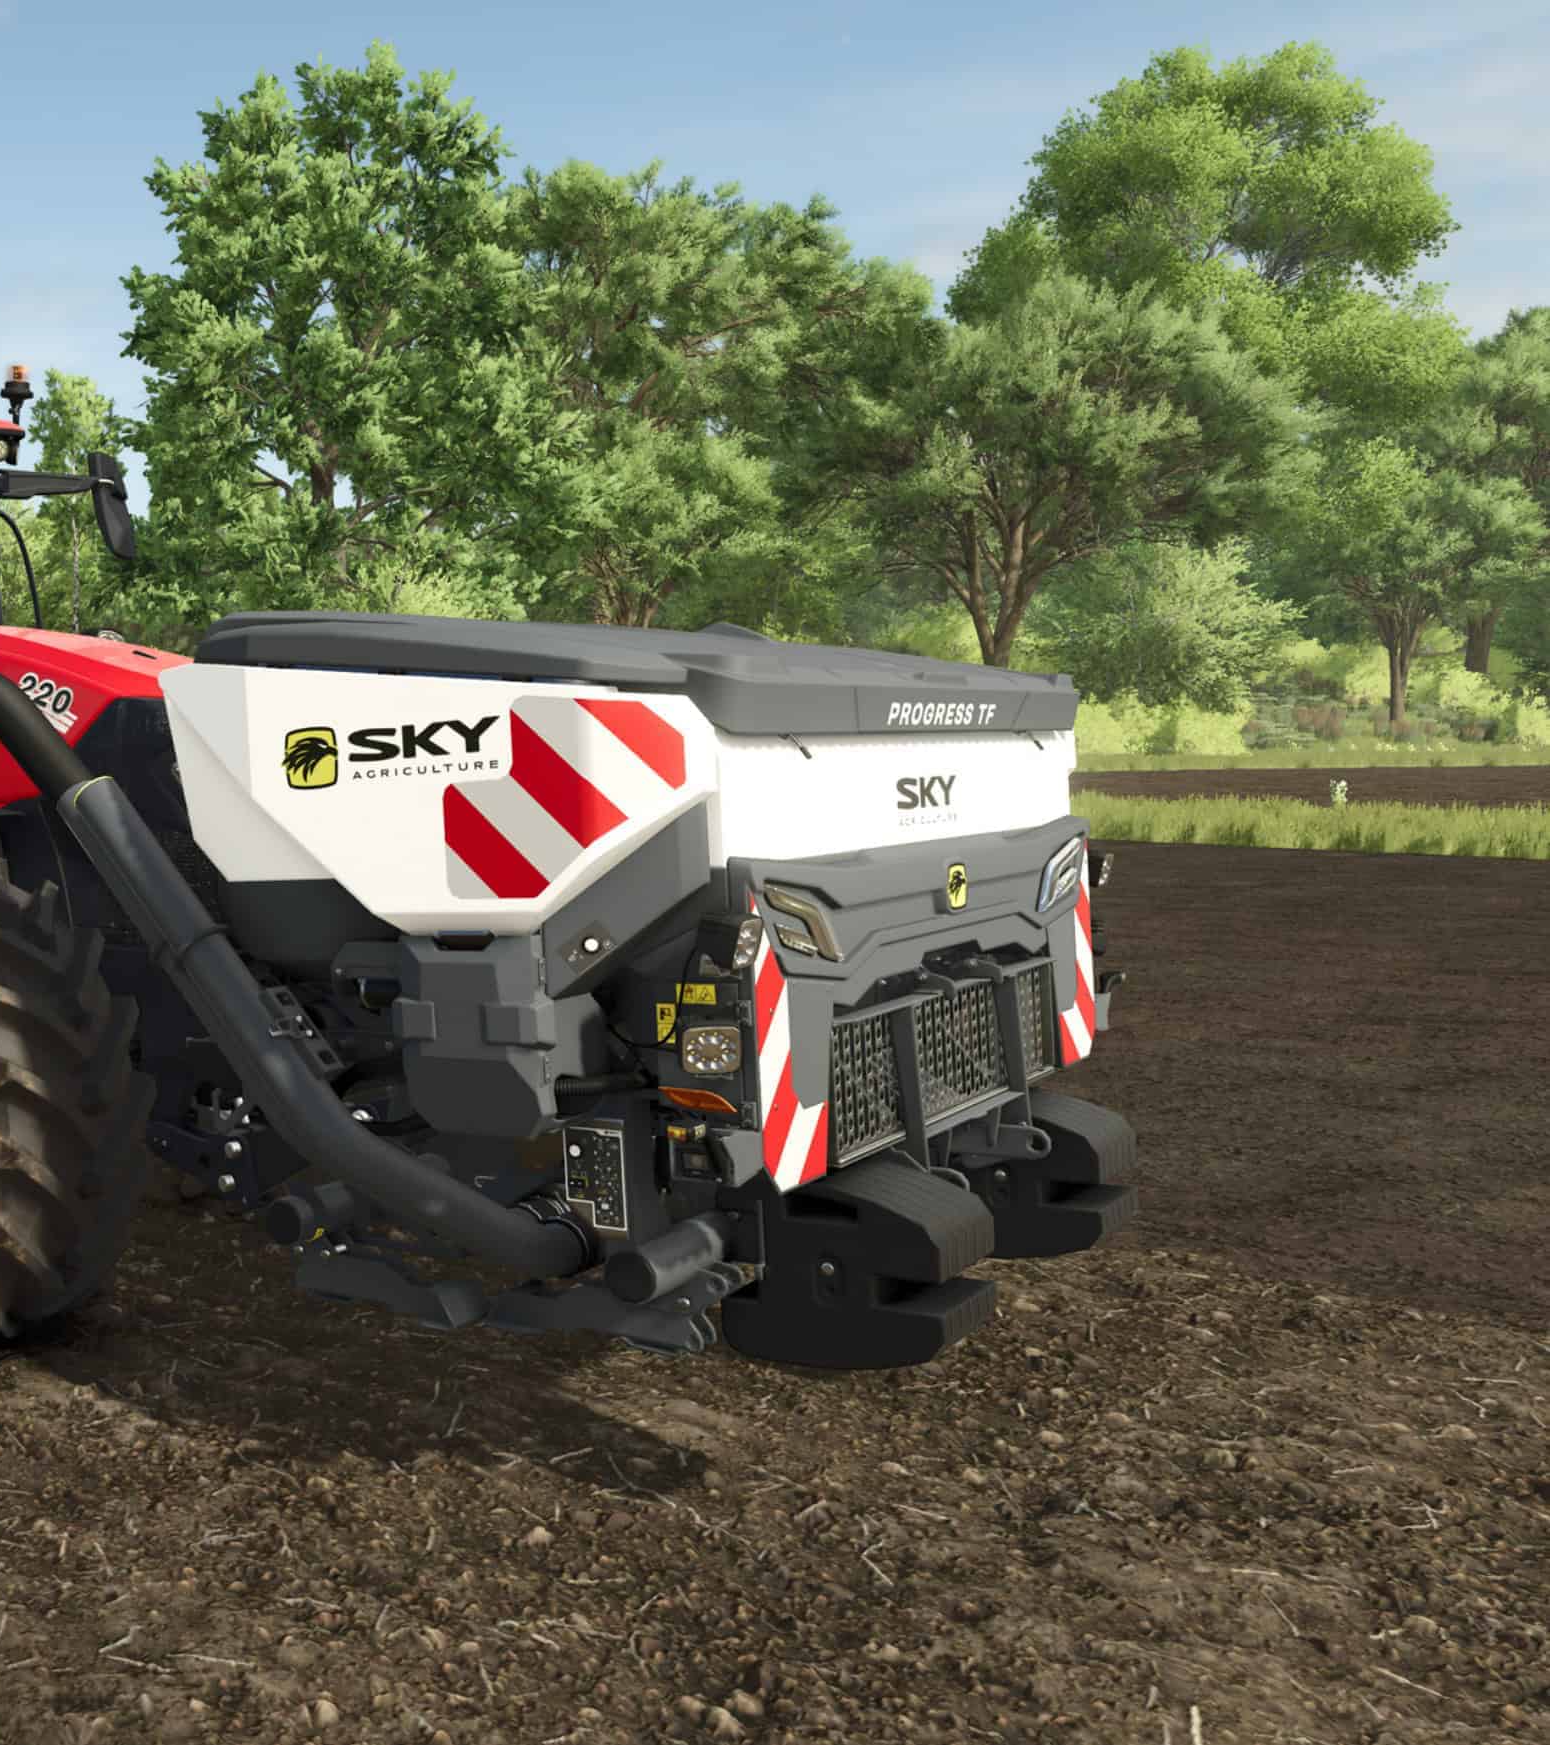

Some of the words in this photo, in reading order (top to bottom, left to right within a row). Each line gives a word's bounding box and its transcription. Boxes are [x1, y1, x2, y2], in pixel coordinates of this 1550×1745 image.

[19, 672, 73, 714] 220
[887, 702, 974, 725] PROGRESS
[977, 703, 997, 725] TF
[347, 715, 500, 762] SKY
[352, 760, 499, 780] AGRICULTURE
[896, 774, 956, 810] SKY
